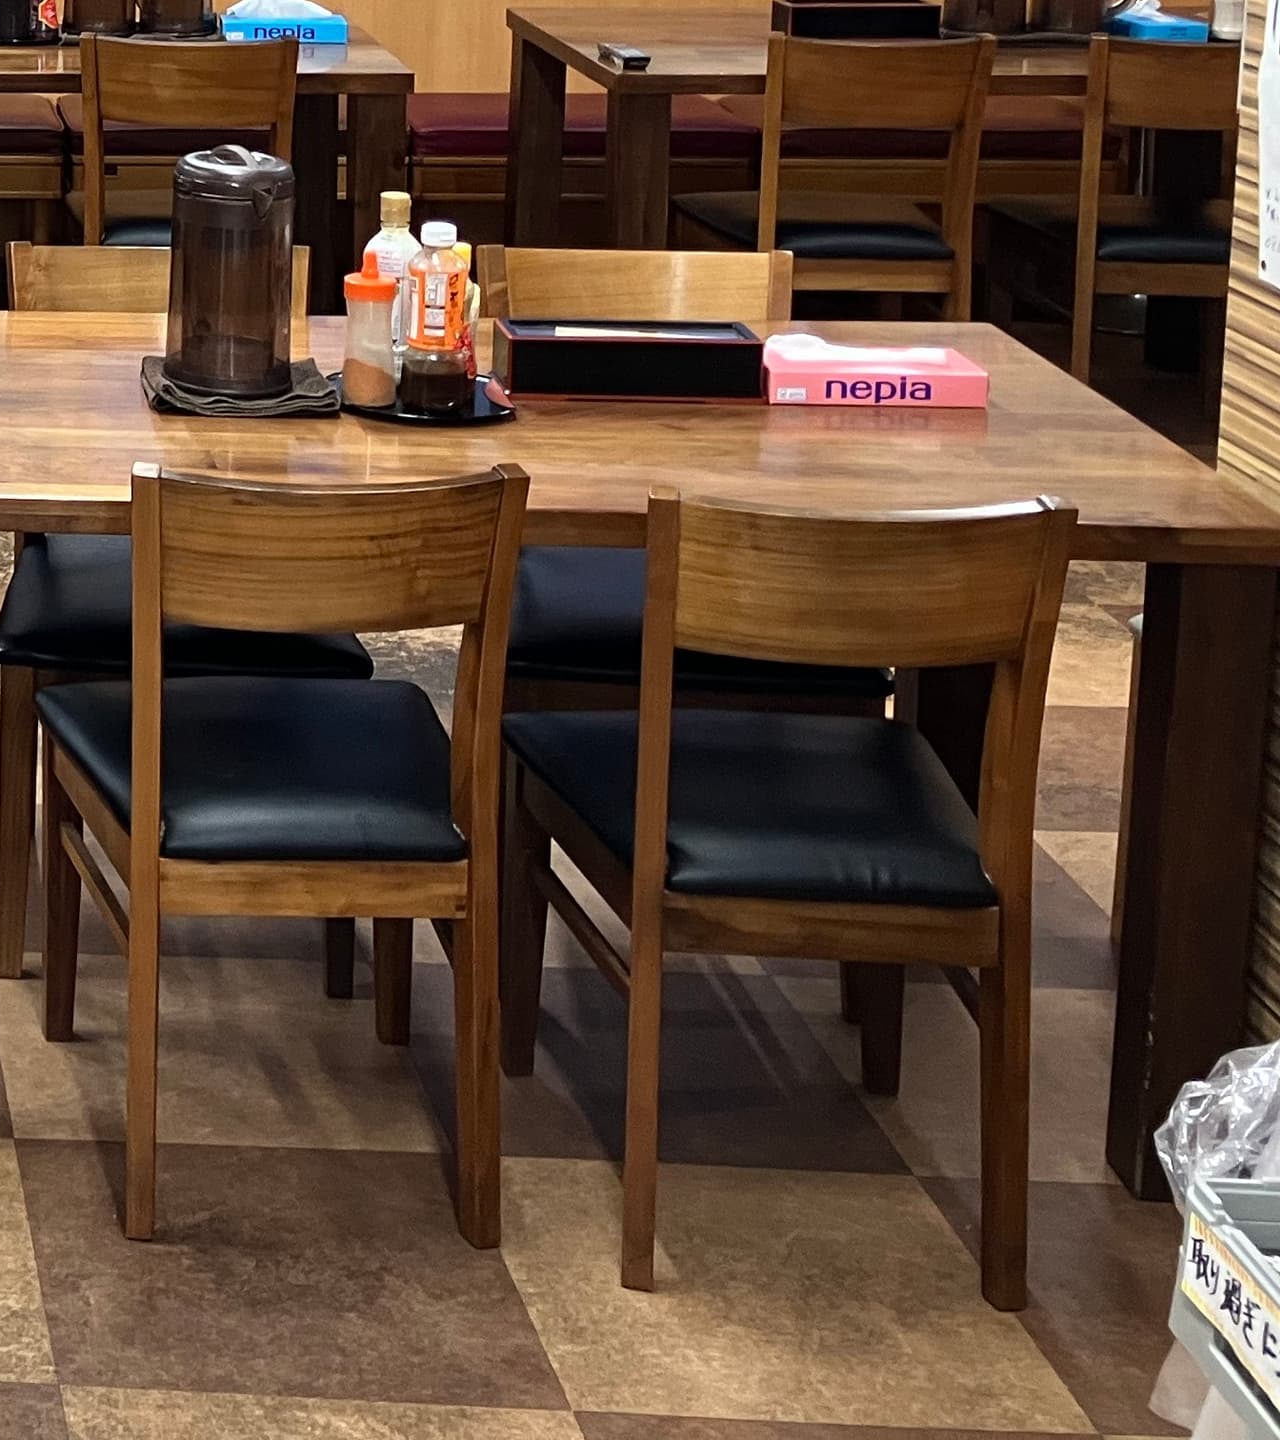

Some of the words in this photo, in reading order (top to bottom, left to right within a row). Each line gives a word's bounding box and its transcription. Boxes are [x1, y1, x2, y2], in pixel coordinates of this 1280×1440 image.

[825, 376, 932, 403] nepia
[1188, 1236, 1280, 1378] 取り過ぎに
